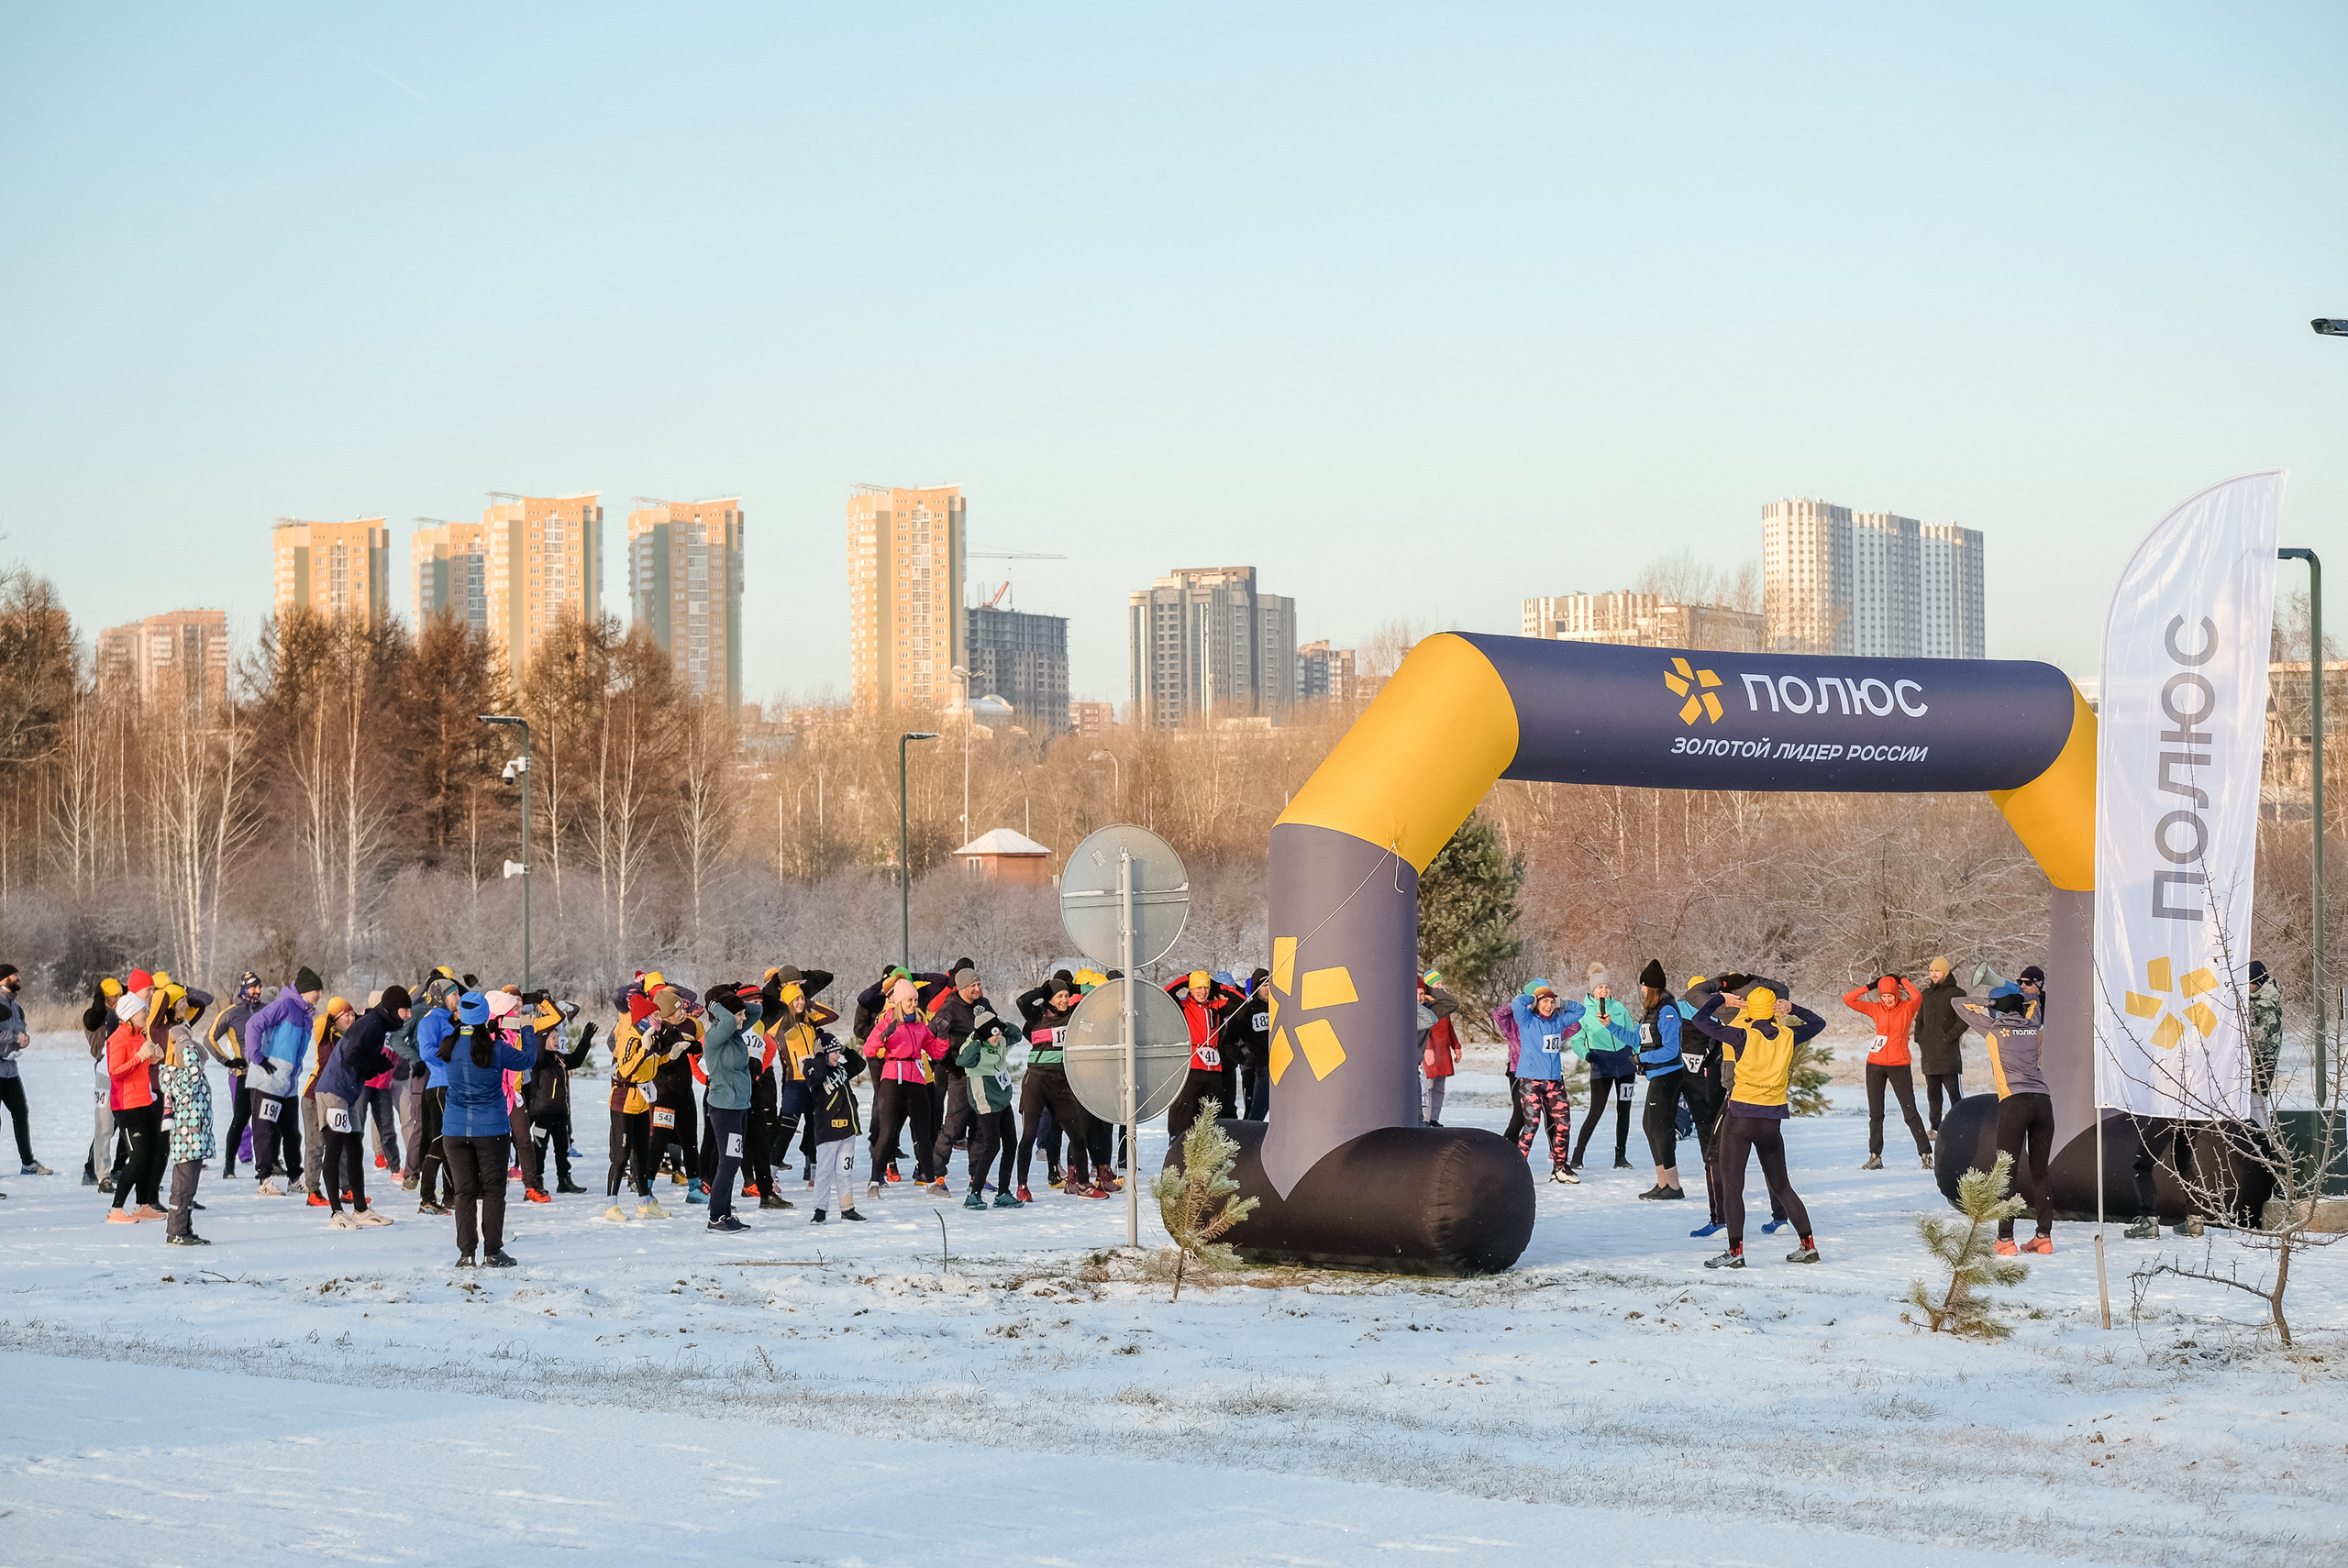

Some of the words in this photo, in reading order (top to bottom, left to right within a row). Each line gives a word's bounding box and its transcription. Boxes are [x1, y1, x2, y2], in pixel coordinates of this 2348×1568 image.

[1740, 673, 1929, 718] ПОЛЮС
[1670, 736, 1771, 758] ЗОЛОТОЙ
[1772, 743, 1843, 763] ЛИДЕР
[1846, 745, 1929, 763] РОССИИ
[2152, 613, 2219, 922] ПОЛЮС
[1545, 1037, 1559, 1050] 187
[658, 1113, 672, 1123] 542
